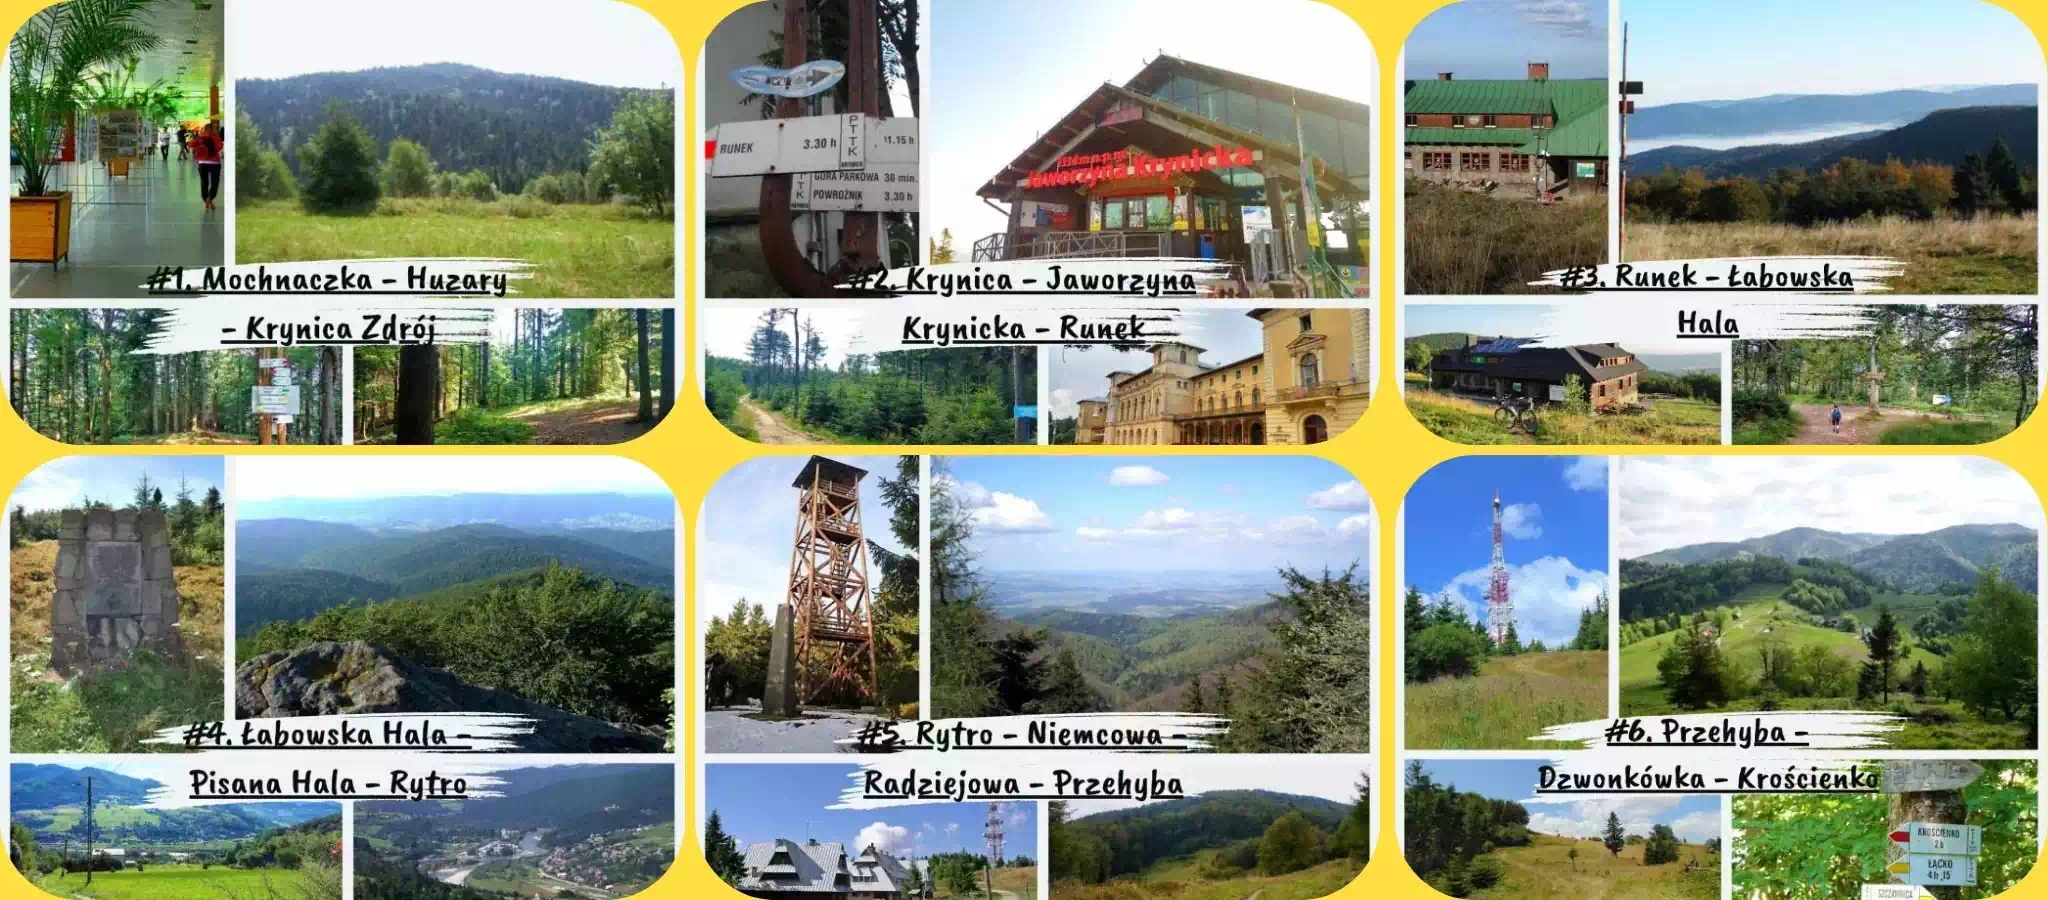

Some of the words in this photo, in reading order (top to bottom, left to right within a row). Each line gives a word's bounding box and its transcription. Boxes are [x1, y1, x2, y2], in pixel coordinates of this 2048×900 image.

[908, 135, 915, 145] h
[720, 142, 754, 154] RUNEK
[803, 138, 828, 150] 3.30
[830, 138, 837, 149] h
[1025, 163, 1127, 188] Jaworzyna
[1133, 144, 1252, 180] Krynicka
[839, 172, 879, 182] PARKOWA
[884, 173, 896, 183] 30
[884, 191, 906, 201] 3.30
[907, 191, 914, 201] h
[1917, 826, 1960, 838] KROŚCIENKO
[1934, 840, 1939, 849] 2
